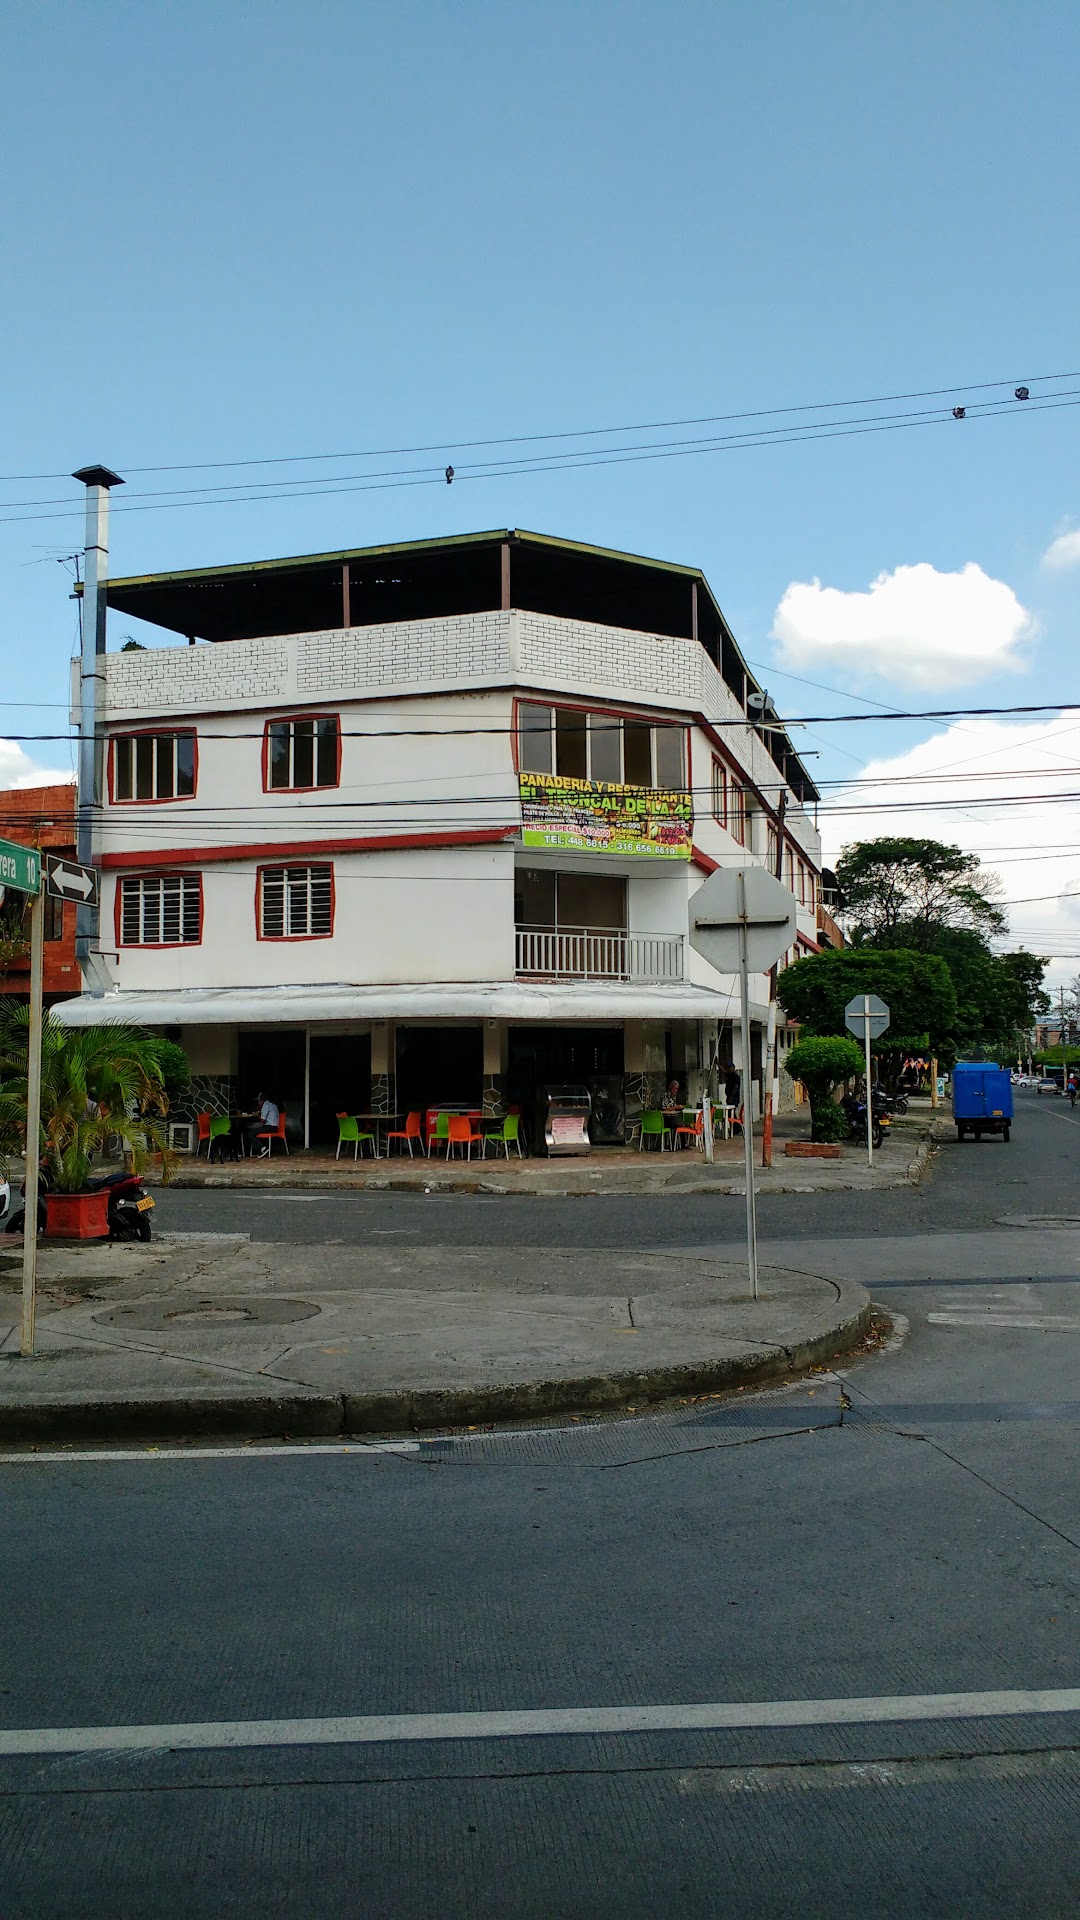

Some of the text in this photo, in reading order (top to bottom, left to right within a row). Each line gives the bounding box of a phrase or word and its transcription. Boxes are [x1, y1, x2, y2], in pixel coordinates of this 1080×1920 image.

[519, 773, 592, 792] PANADERIA
[595, 780, 604, 793] Y
[520, 786, 541, 802] EL
[545, 788, 621, 810] TRONCAL
[625, 797, 646, 814] DE
[651, 801, 669, 816] LA
[674, 803, 692, 820] 44
[550, 825, 581, 834] ESPECIAL
[583, 827, 609, 837] $10.000
[544, 835, 565, 845] TEL:
[568, 837, 583, 846] 448
[617, 842, 633, 851] 318
[636, 844, 652, 853] 656
[27, 856, 35, 885] 10
